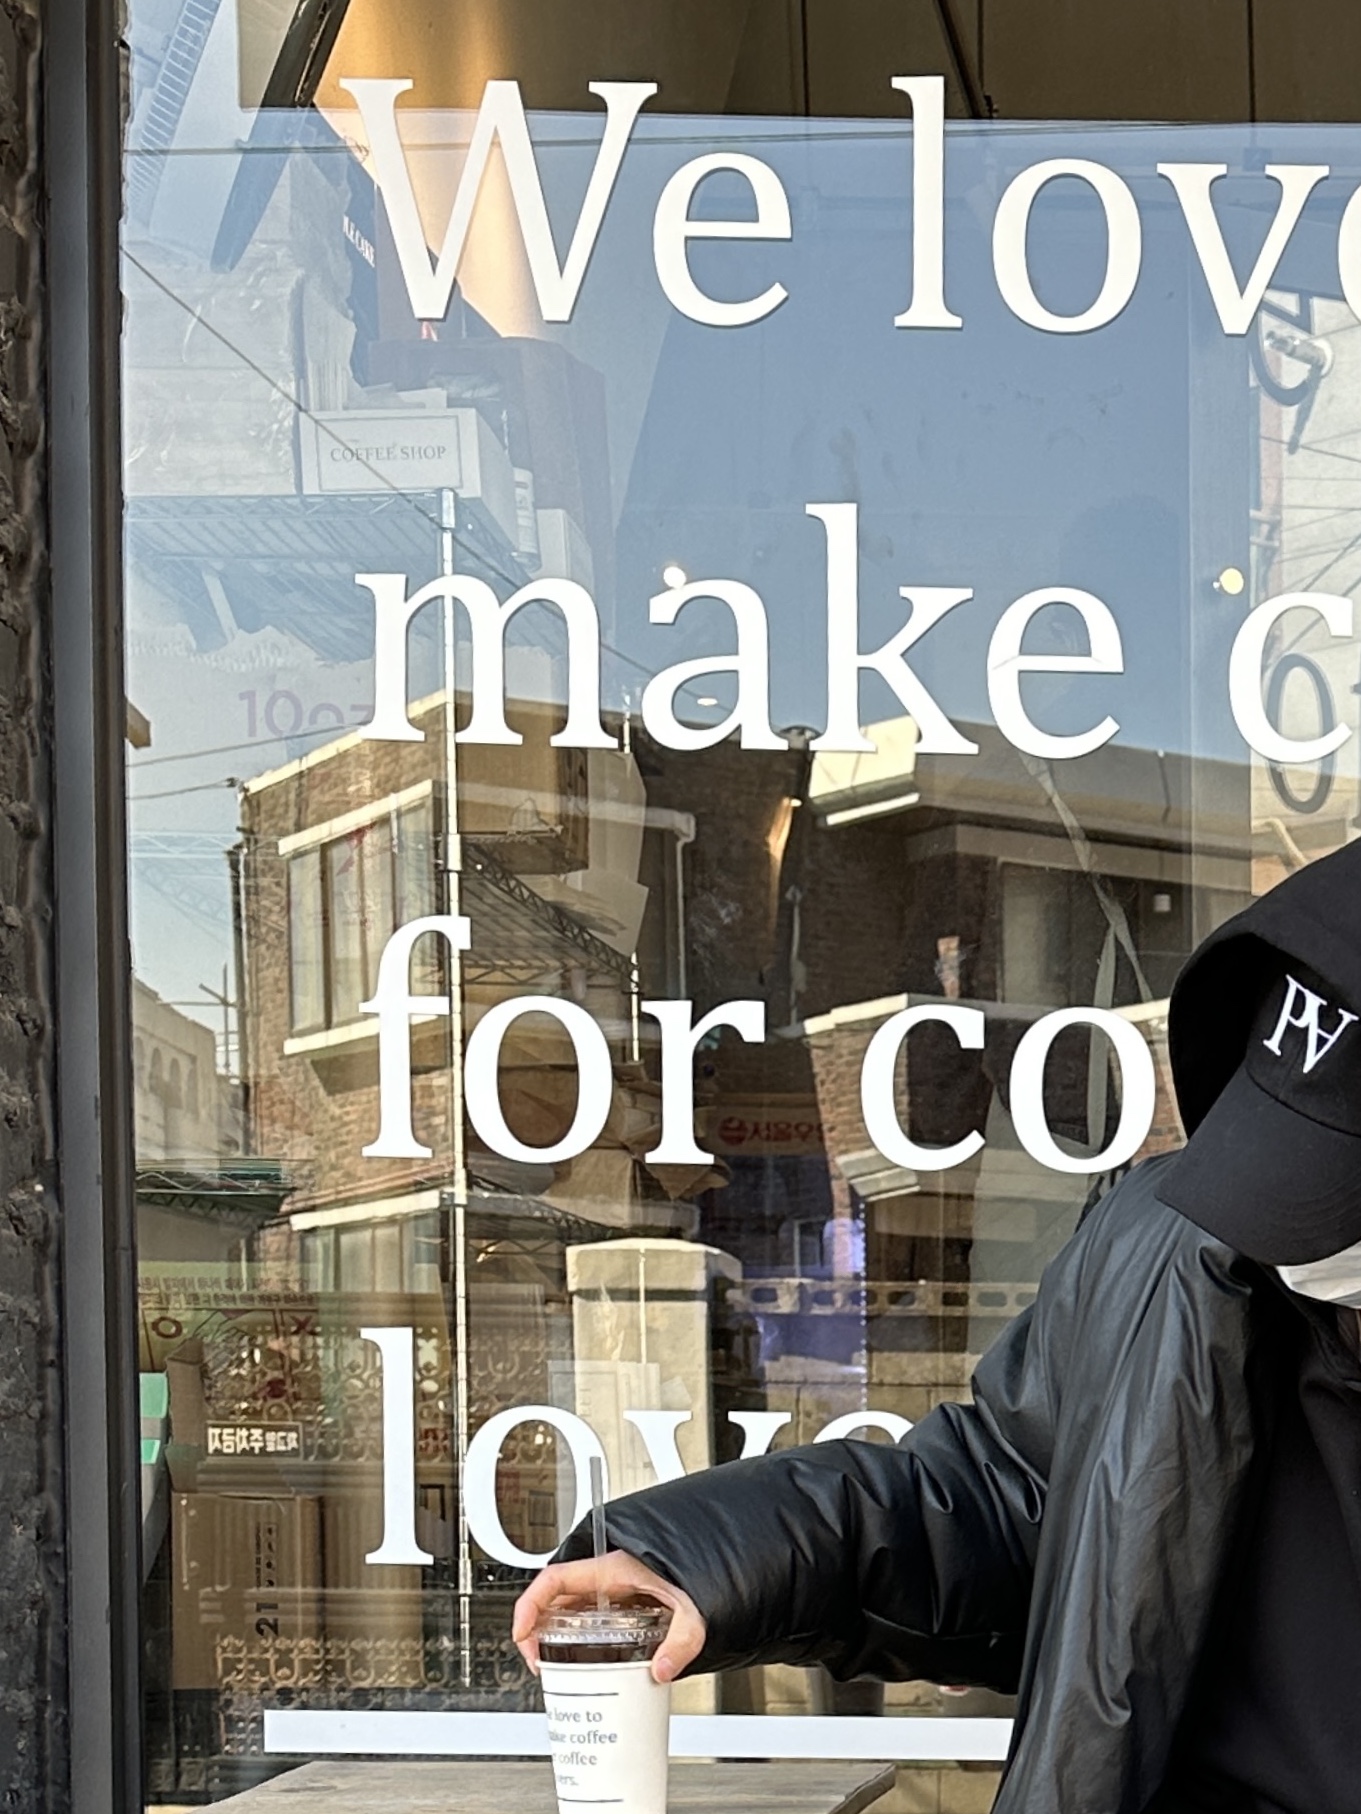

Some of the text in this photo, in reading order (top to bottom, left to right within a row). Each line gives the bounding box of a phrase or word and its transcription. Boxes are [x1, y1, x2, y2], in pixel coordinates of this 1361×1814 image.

[340, 77, 792, 327] We
[330, 444, 446, 462] COFFEE SHOP
[355, 502, 1125, 760] make
[359, 914, 765, 1164] for
[255, 1602, 279, 1636] 21
[554, 1708, 581, 1723] love
[586, 1711, 603, 1723] to
[570, 1730, 618, 1744] coffee
[559, 1751, 598, 1765] coffee
